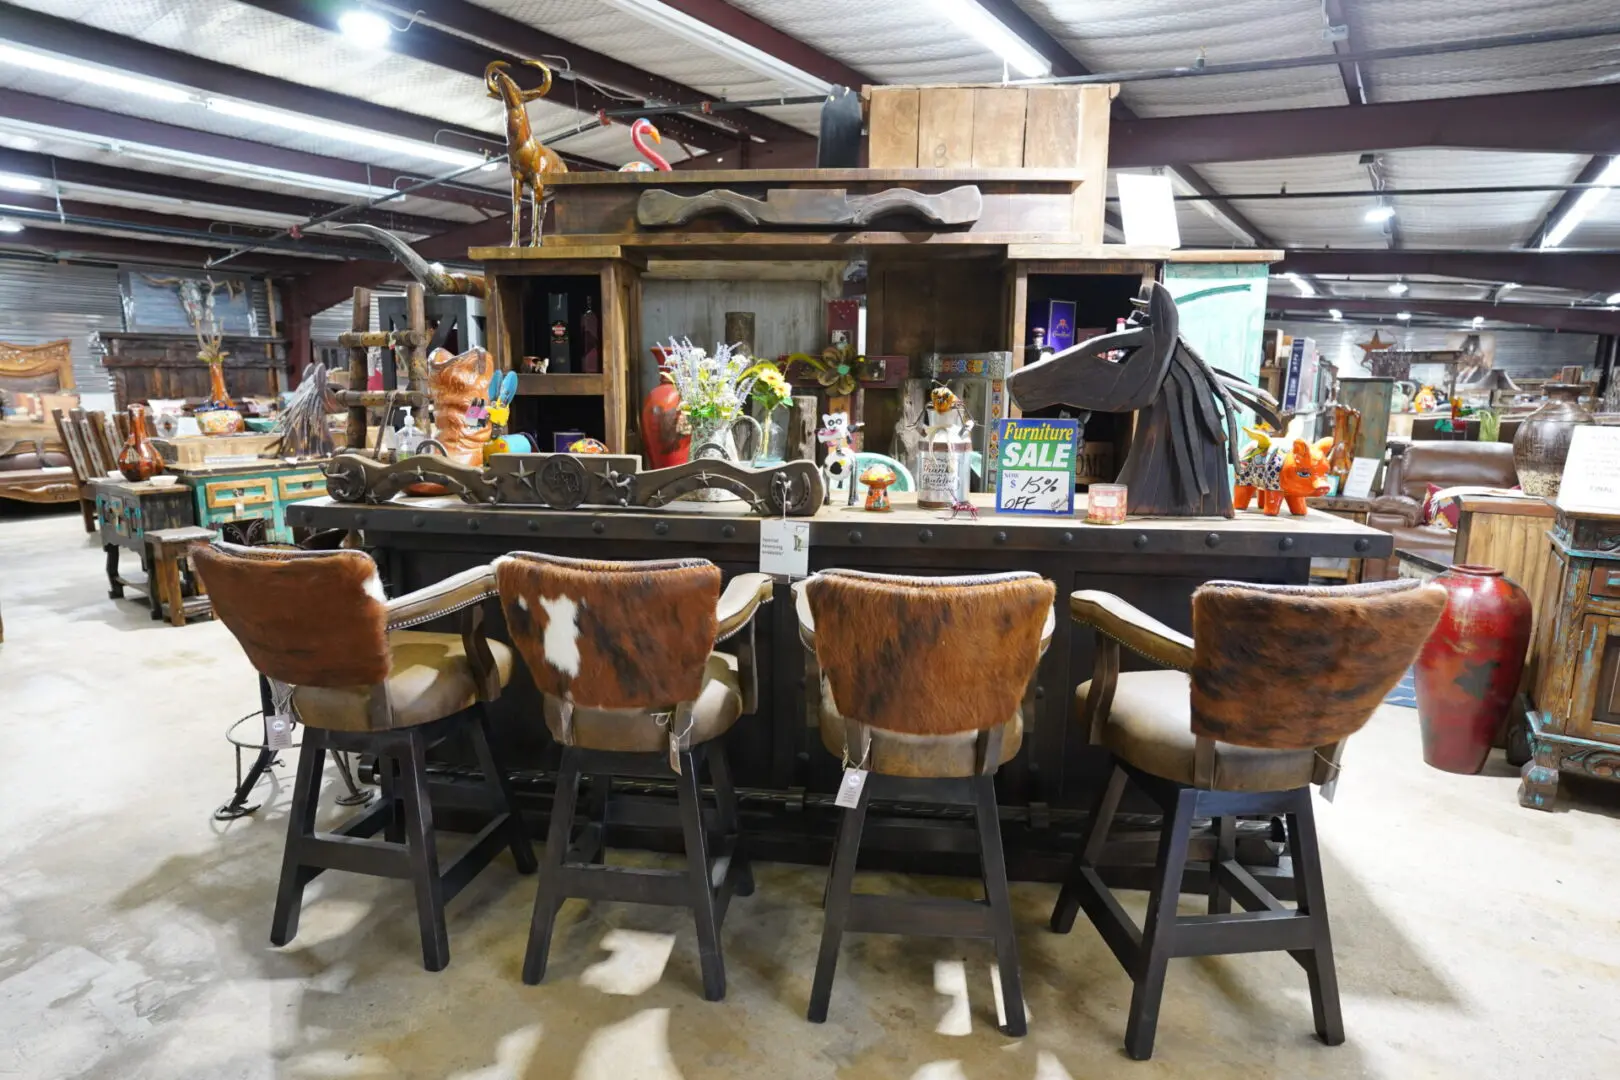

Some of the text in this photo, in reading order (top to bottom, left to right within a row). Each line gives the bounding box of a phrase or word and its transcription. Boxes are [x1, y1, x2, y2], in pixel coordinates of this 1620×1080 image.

[1003, 422, 1073, 441] Furniture
[1002, 442, 1072, 468] SALE
[1020, 476, 1059, 494] 15%
[1004, 496, 1036, 511] OFF
